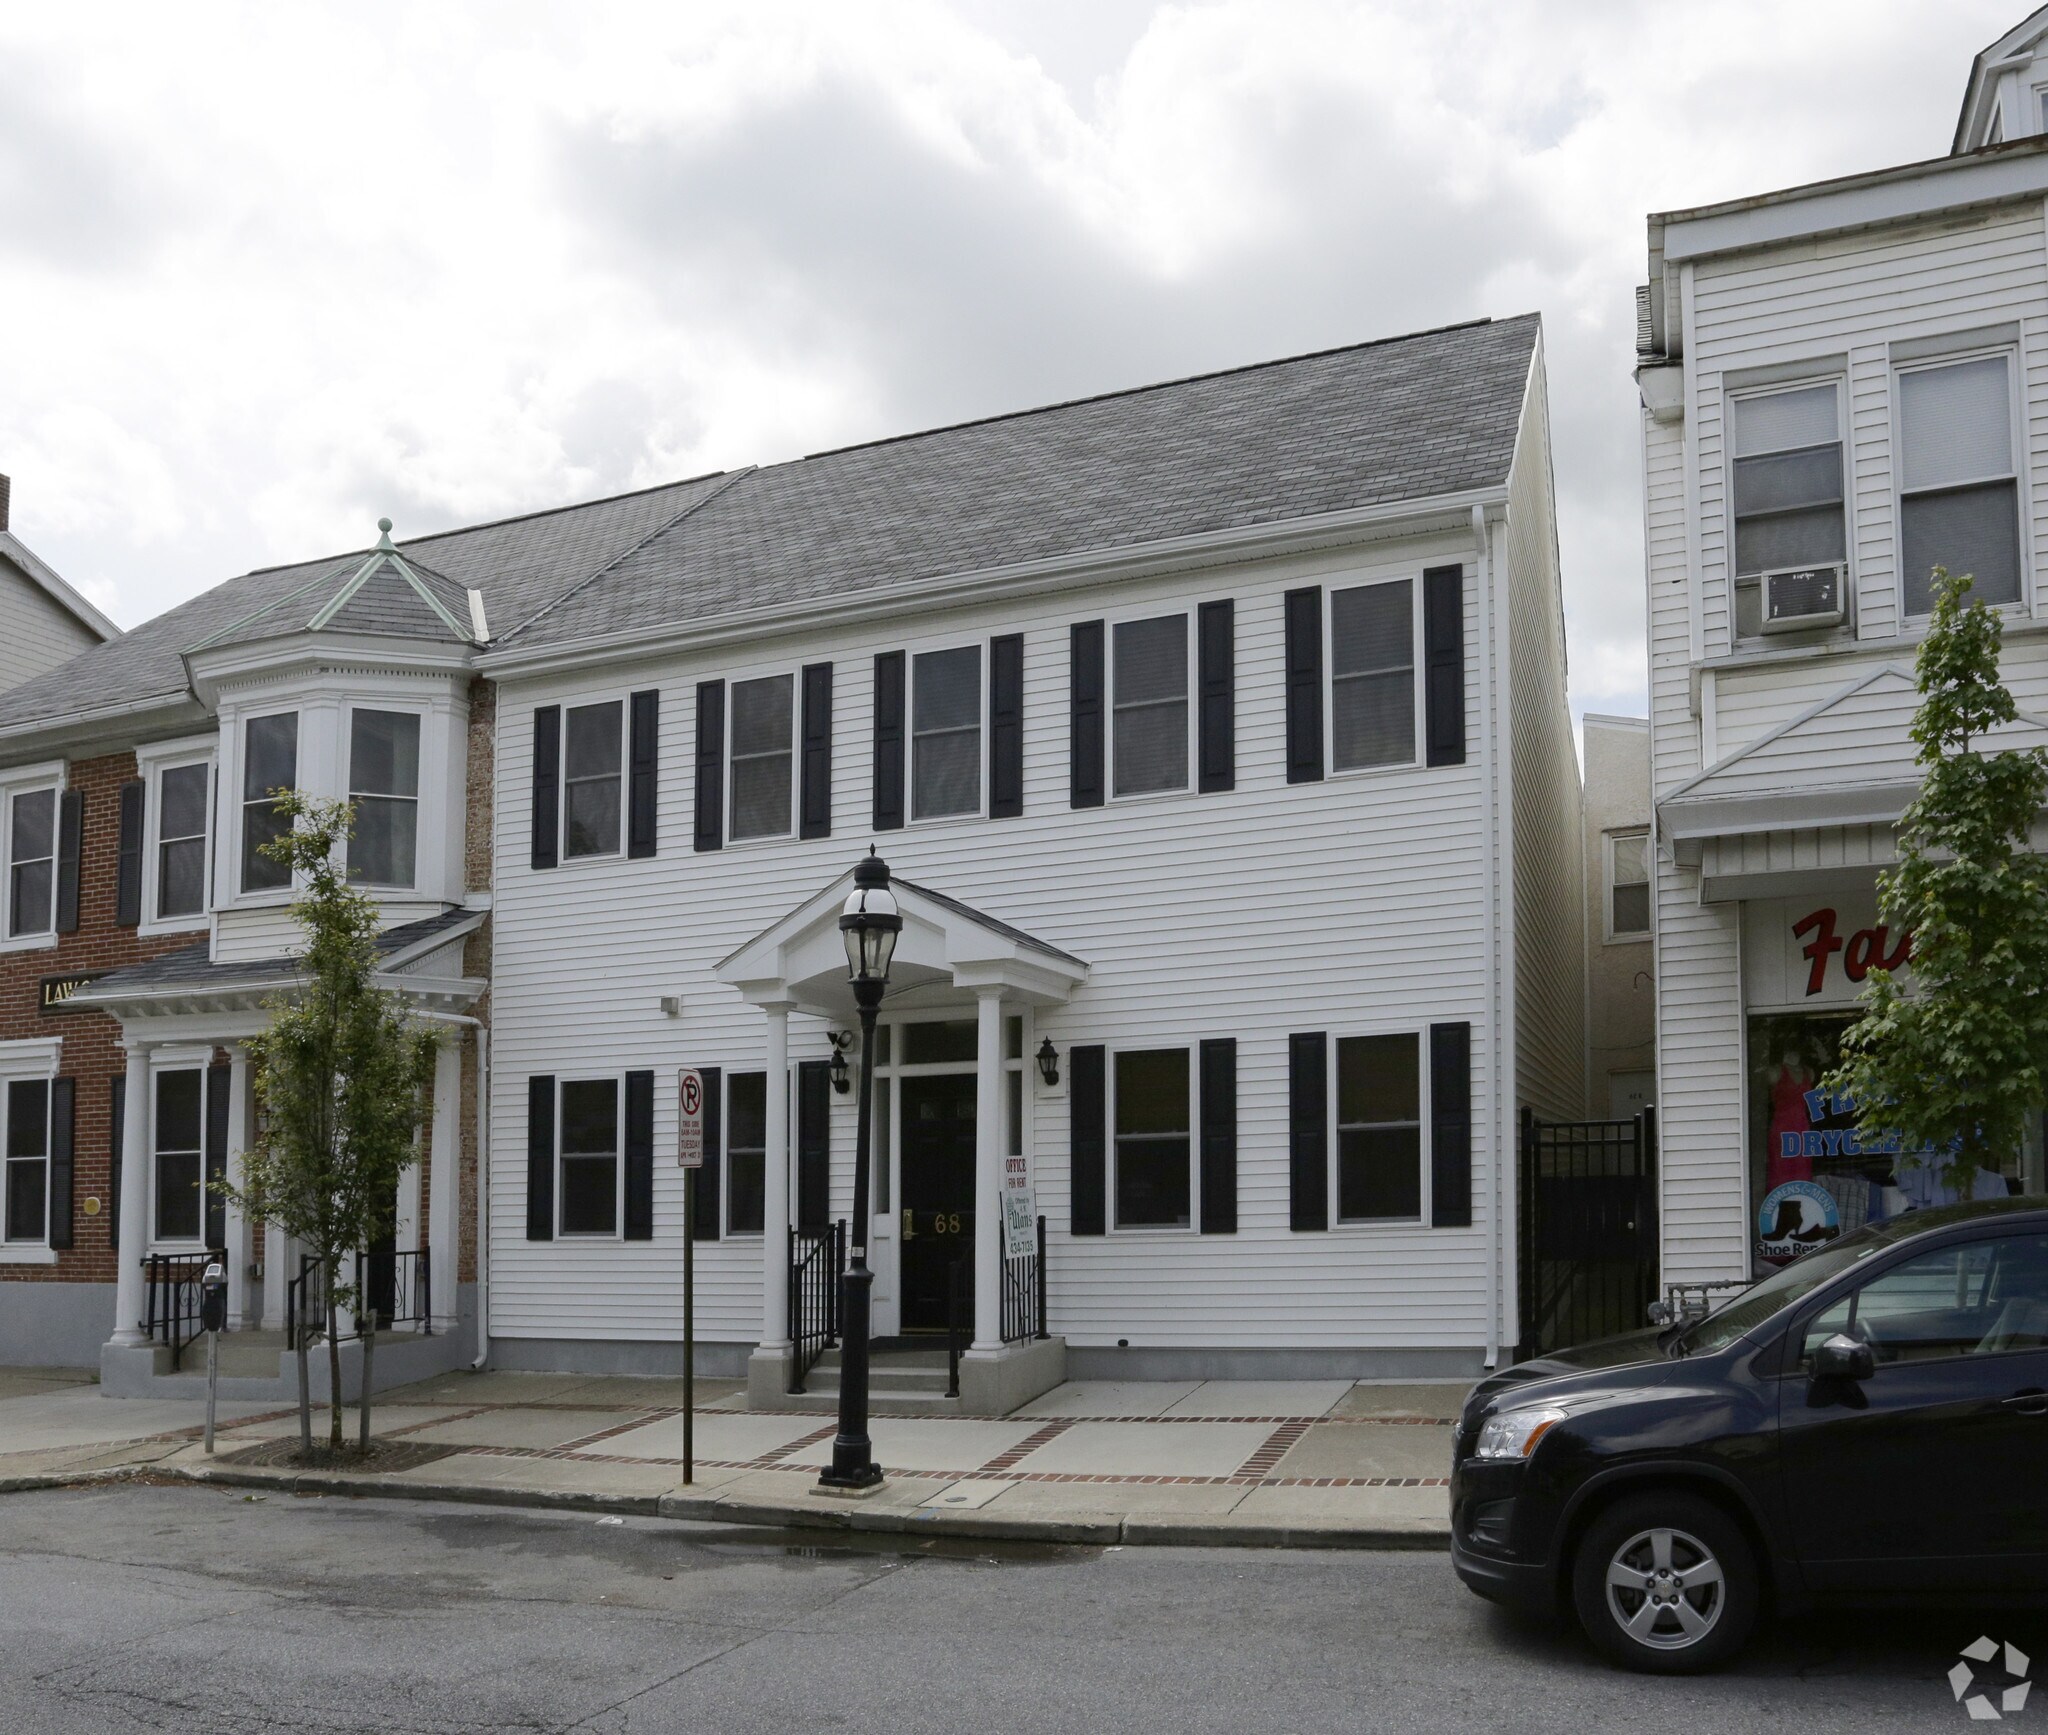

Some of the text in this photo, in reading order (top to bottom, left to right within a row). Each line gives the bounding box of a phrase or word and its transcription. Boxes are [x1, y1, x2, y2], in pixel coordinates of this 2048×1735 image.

[681, 1140, 701, 1149] TUESDAY
[1005, 1158, 1027, 1173] OFFICE
[1008, 1176, 1027, 1188] FOR RENT
[1763, 1184, 1835, 1215] WOMENS & MENS
[935, 1213, 961, 1234] 68
[1010, 1239, 1034, 1255] 434-7135
[1755, 1242, 1791, 1256] Shoe
